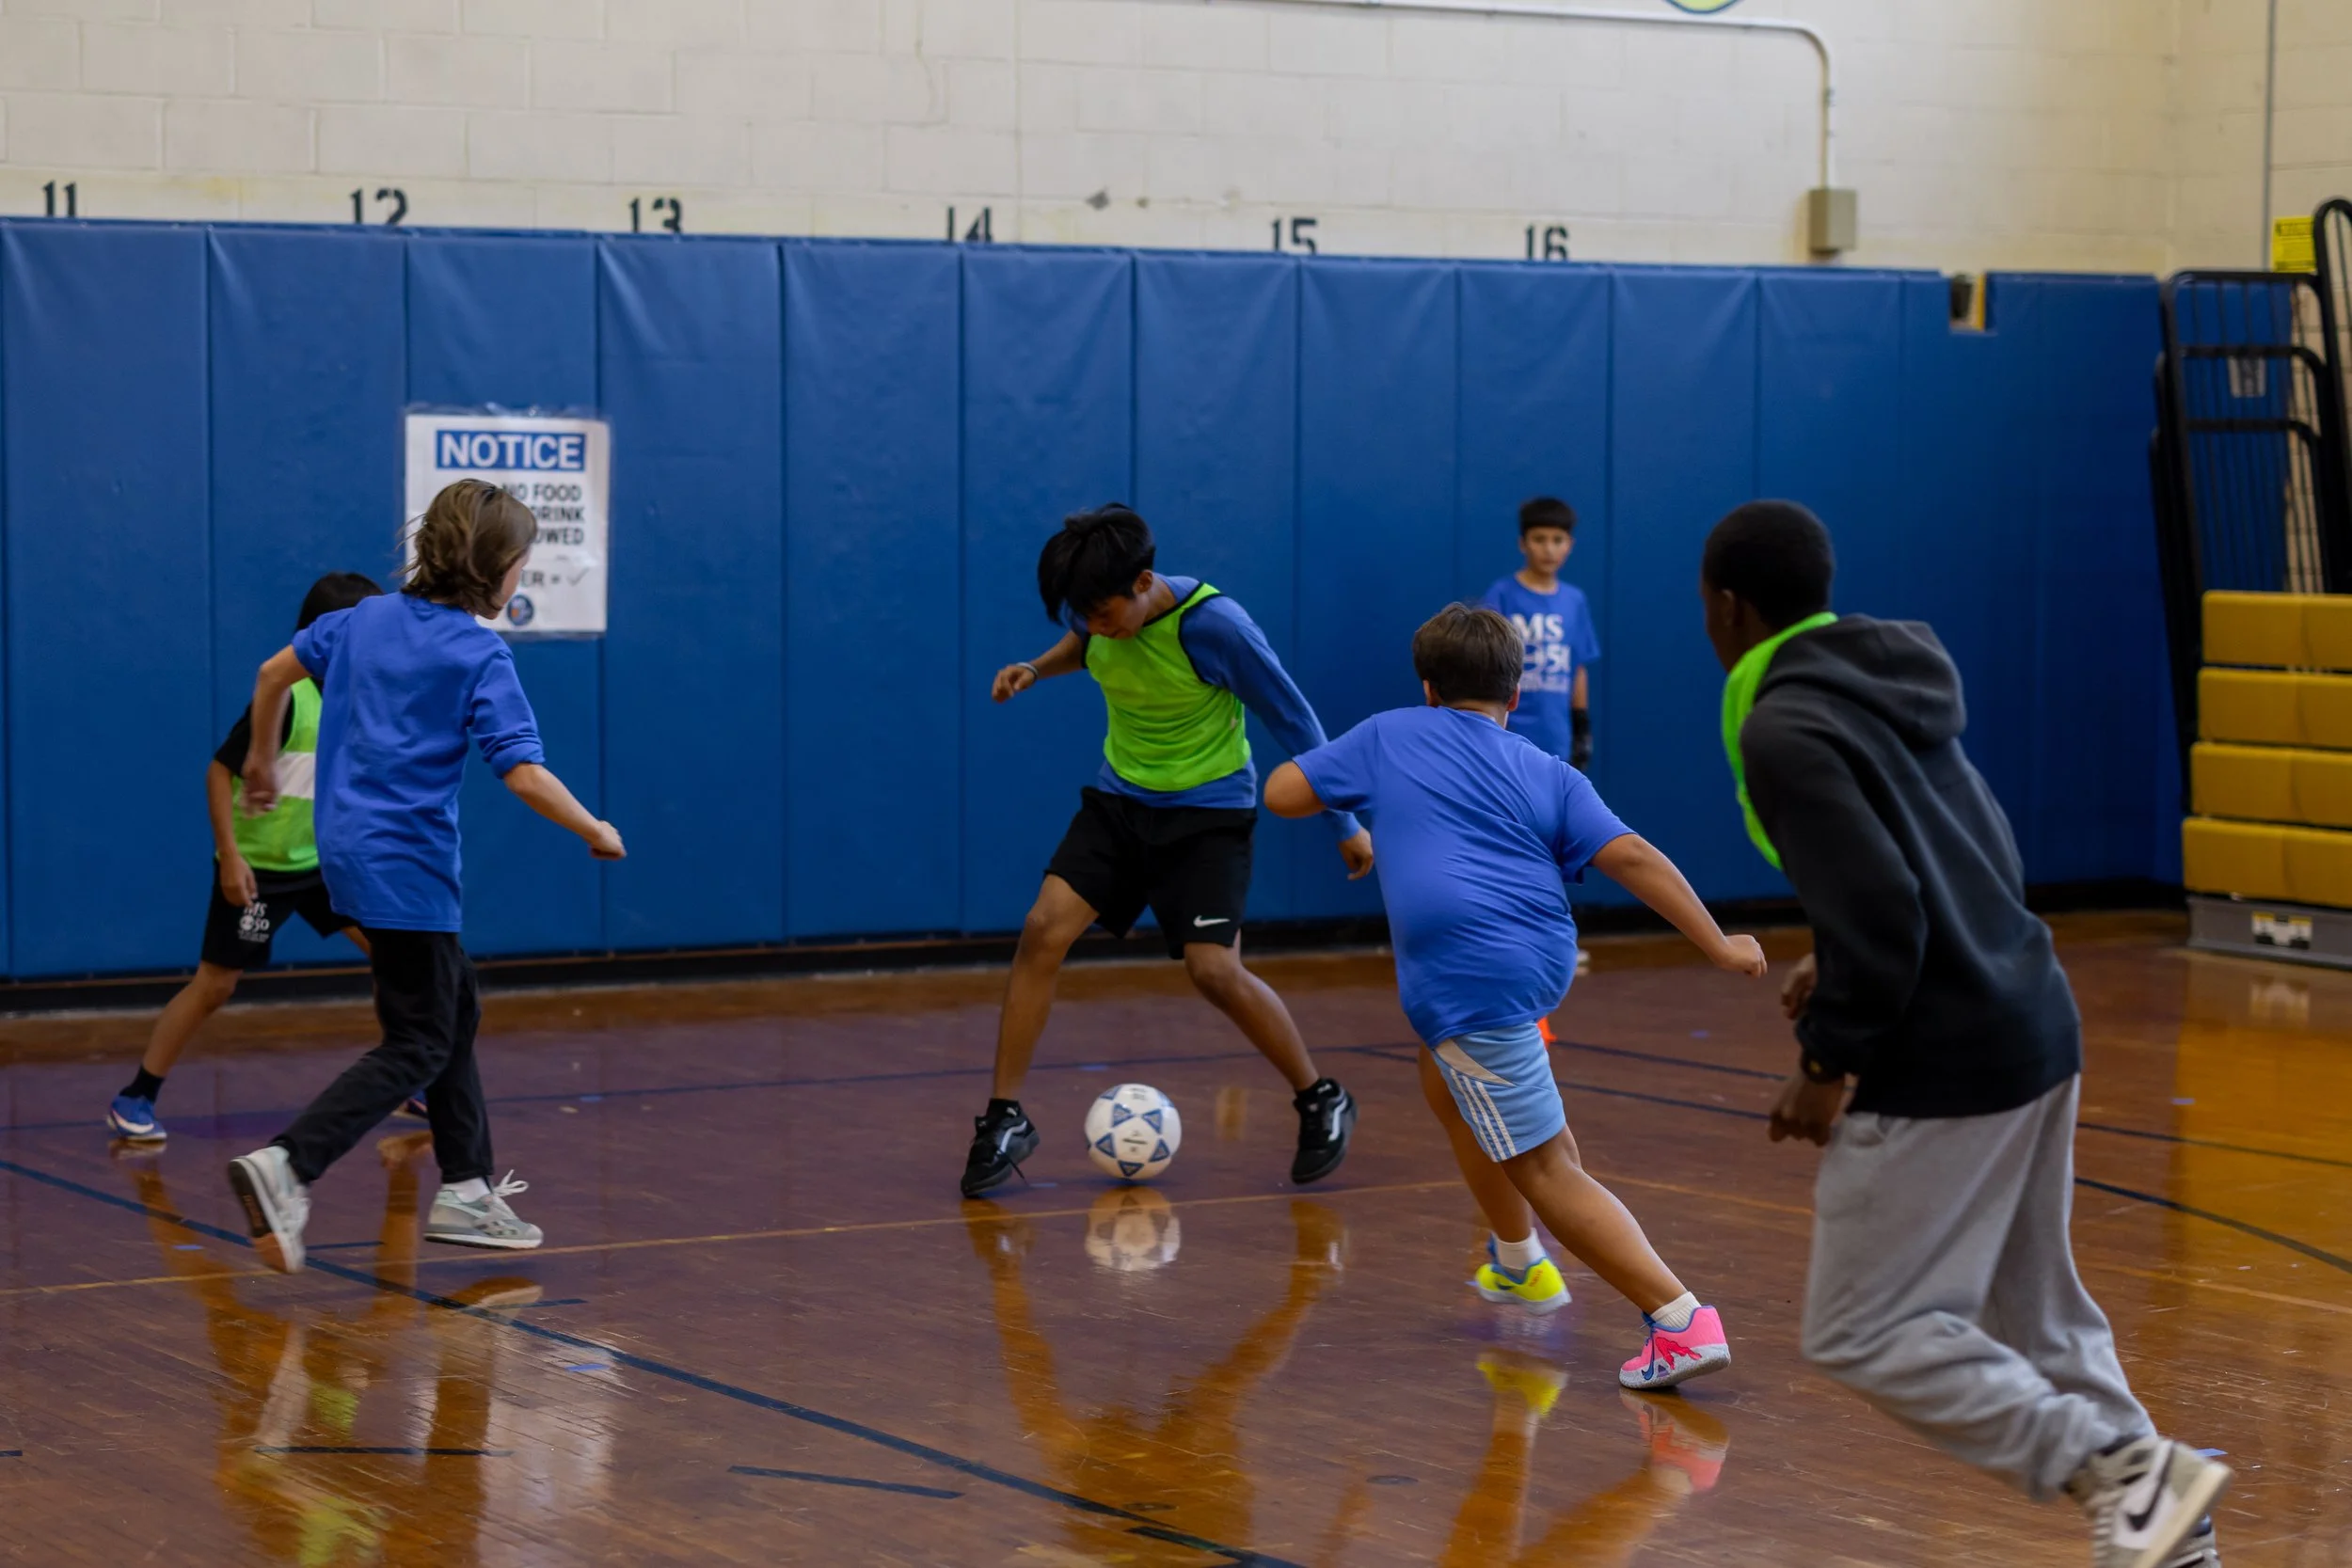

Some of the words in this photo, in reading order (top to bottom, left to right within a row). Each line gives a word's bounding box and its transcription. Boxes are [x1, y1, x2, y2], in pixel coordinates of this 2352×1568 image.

[43, 181, 76, 216] 11
[350, 186, 408, 225] 12
[629, 198, 683, 233] 13
[946, 206, 992, 242] 14
[1271, 216, 1317, 255] 15
[1525, 224, 1568, 261] 16
[441, 434, 581, 469] NOTICE
[532, 483, 582, 502] FOOD
